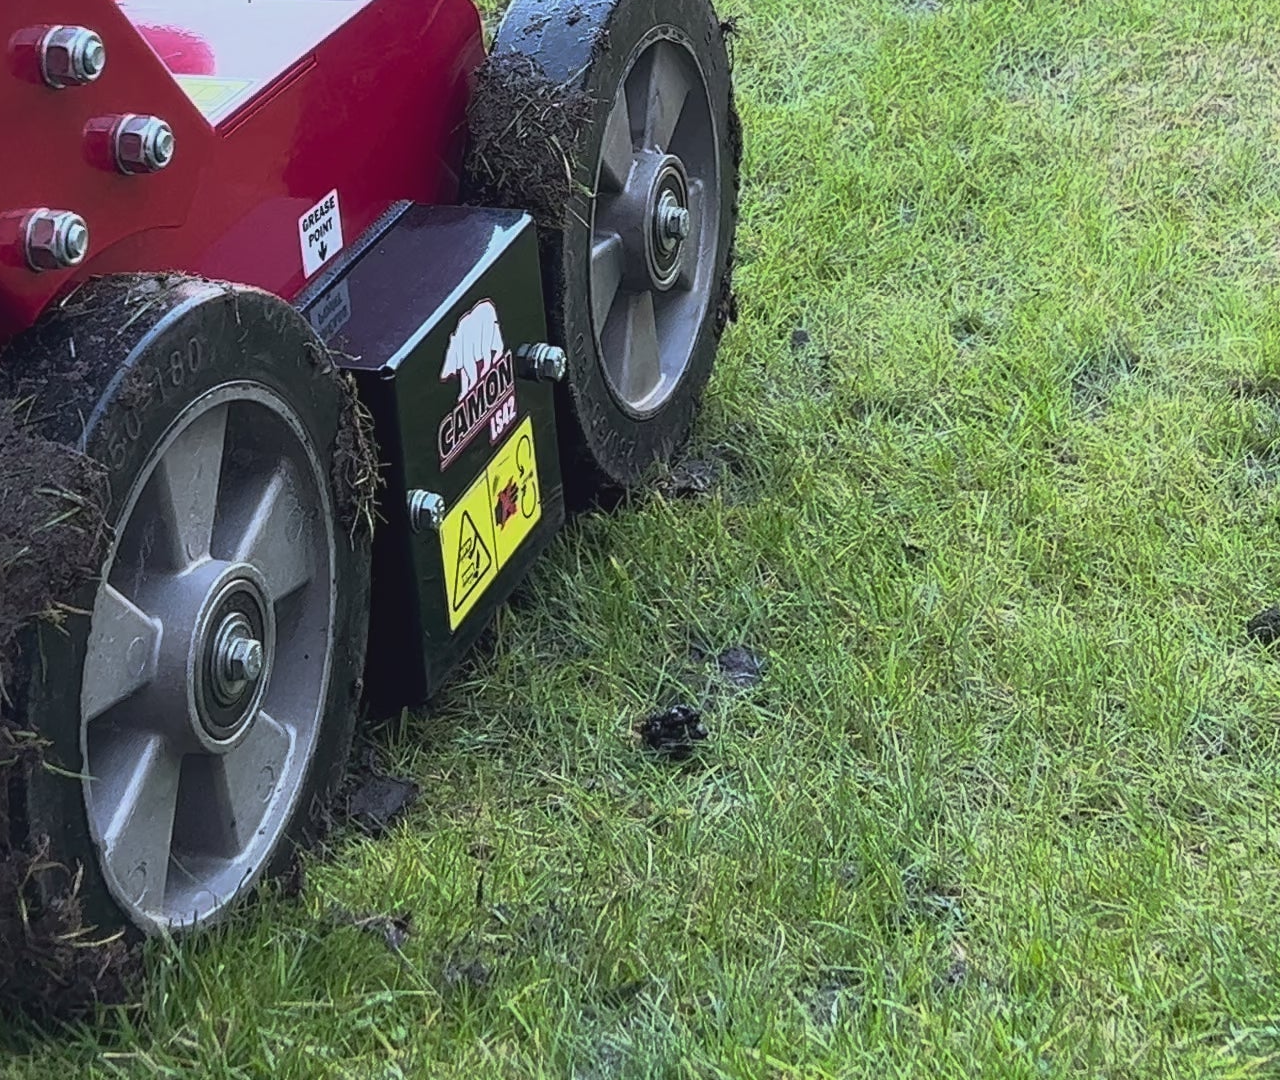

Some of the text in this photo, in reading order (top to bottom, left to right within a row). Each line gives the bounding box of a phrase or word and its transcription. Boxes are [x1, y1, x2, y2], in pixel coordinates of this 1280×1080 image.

[302, 195, 336, 233] GREASE
[308, 217, 333, 248] POINT
[438, 349, 515, 459] CAMON
